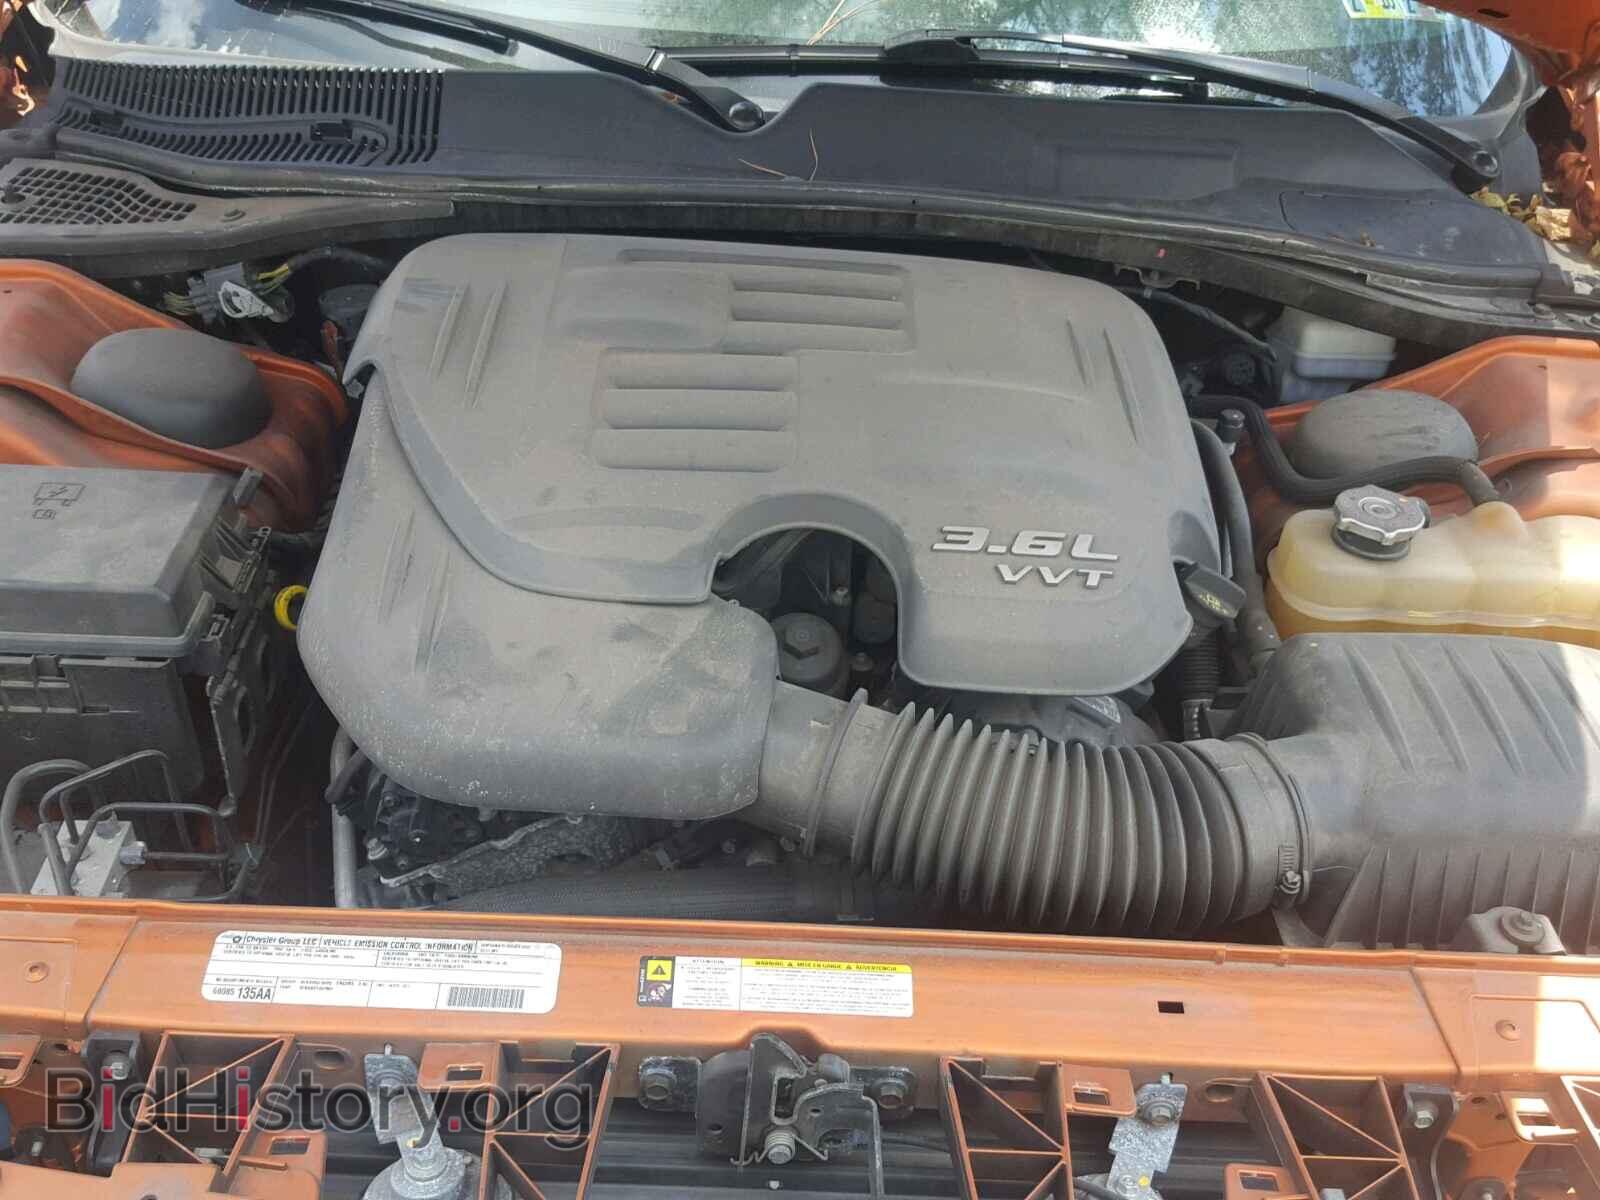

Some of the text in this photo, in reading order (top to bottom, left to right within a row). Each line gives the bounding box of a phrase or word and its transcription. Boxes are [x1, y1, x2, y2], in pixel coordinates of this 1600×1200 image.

[931, 525, 1119, 561] 3.6L
[996, 564, 1114, 589] VVT
[246, 935, 318, 946] Chrysler Group LLC
[323, 938, 352, 947] VEHICLE
[354, 939, 388, 949] EMISSION
[390, 941, 422, 950] CONTROL
[425, 942, 473, 952] INFORMATION
[237, 987, 272, 1001] 135AA
